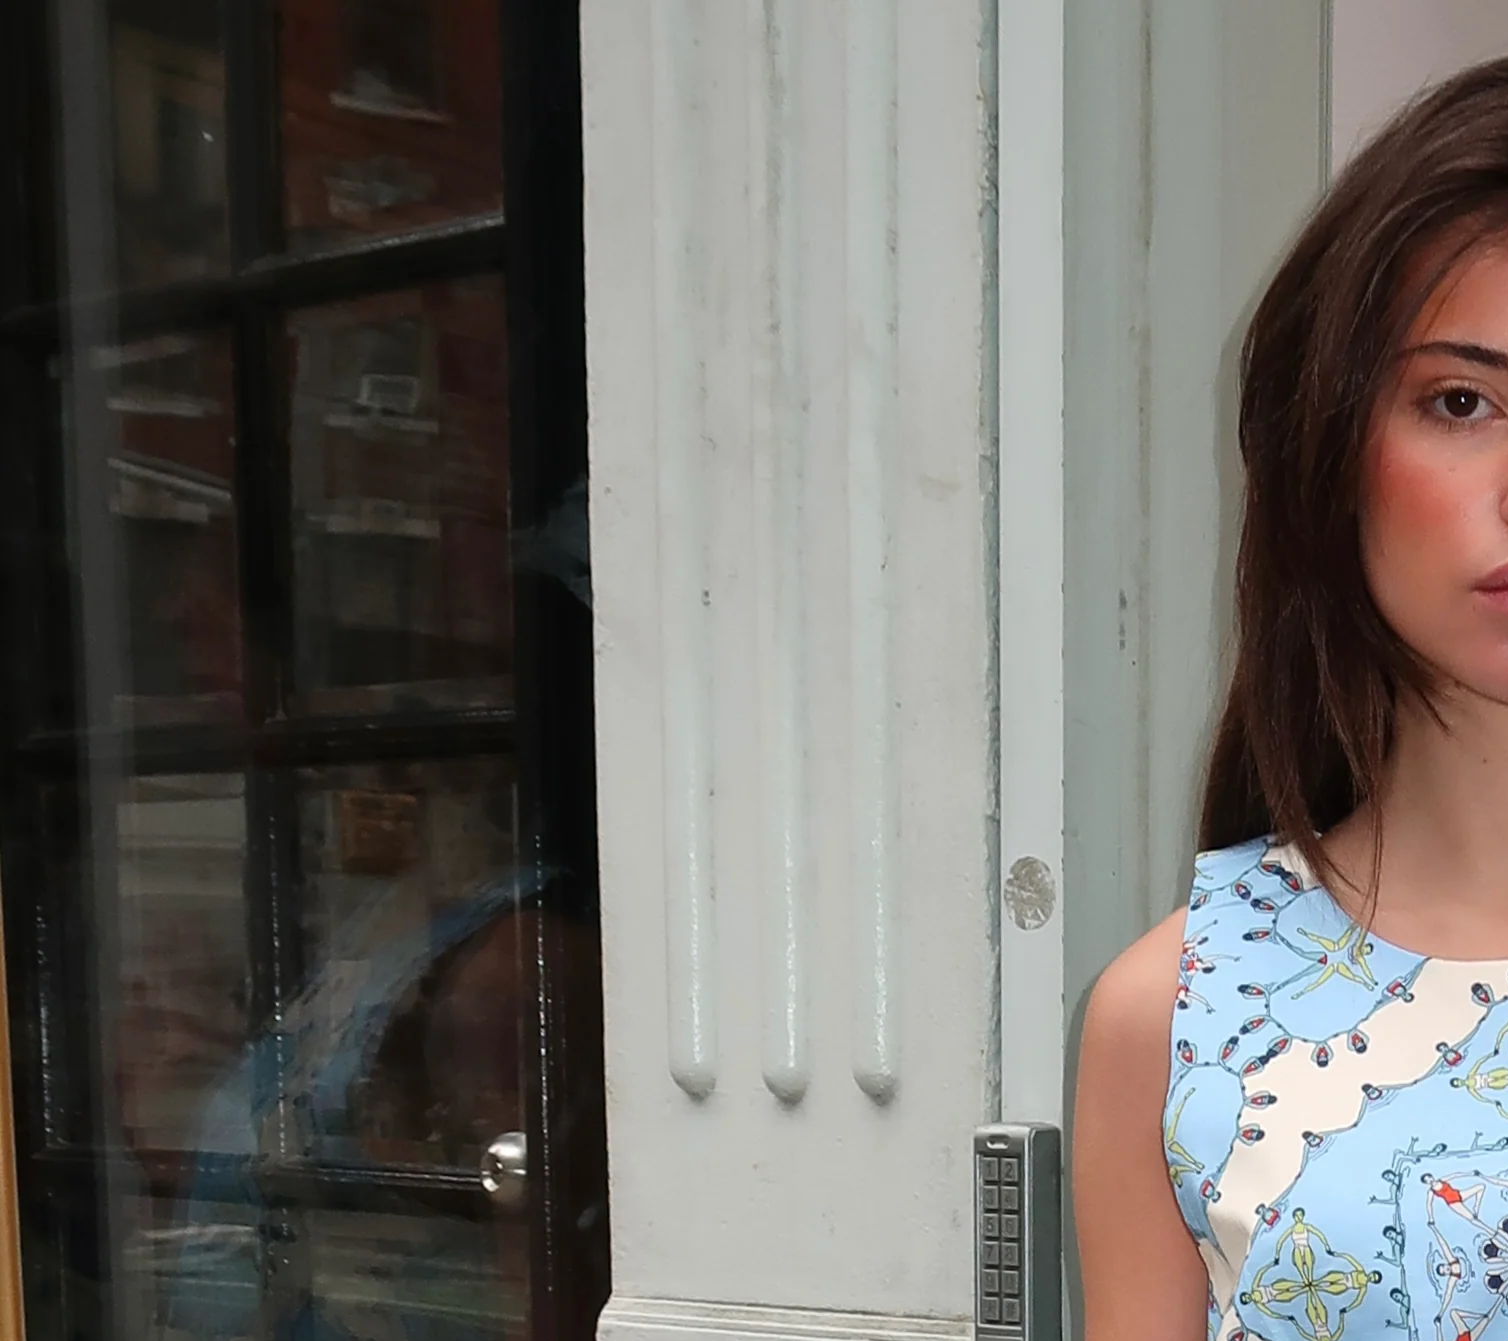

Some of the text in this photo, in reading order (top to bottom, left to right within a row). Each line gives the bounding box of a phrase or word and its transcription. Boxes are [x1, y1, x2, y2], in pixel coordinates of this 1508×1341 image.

[1004, 1161, 1013, 1178] 2
[985, 1217, 994, 1233] 5
[985, 1244, 994, 1259] 7
